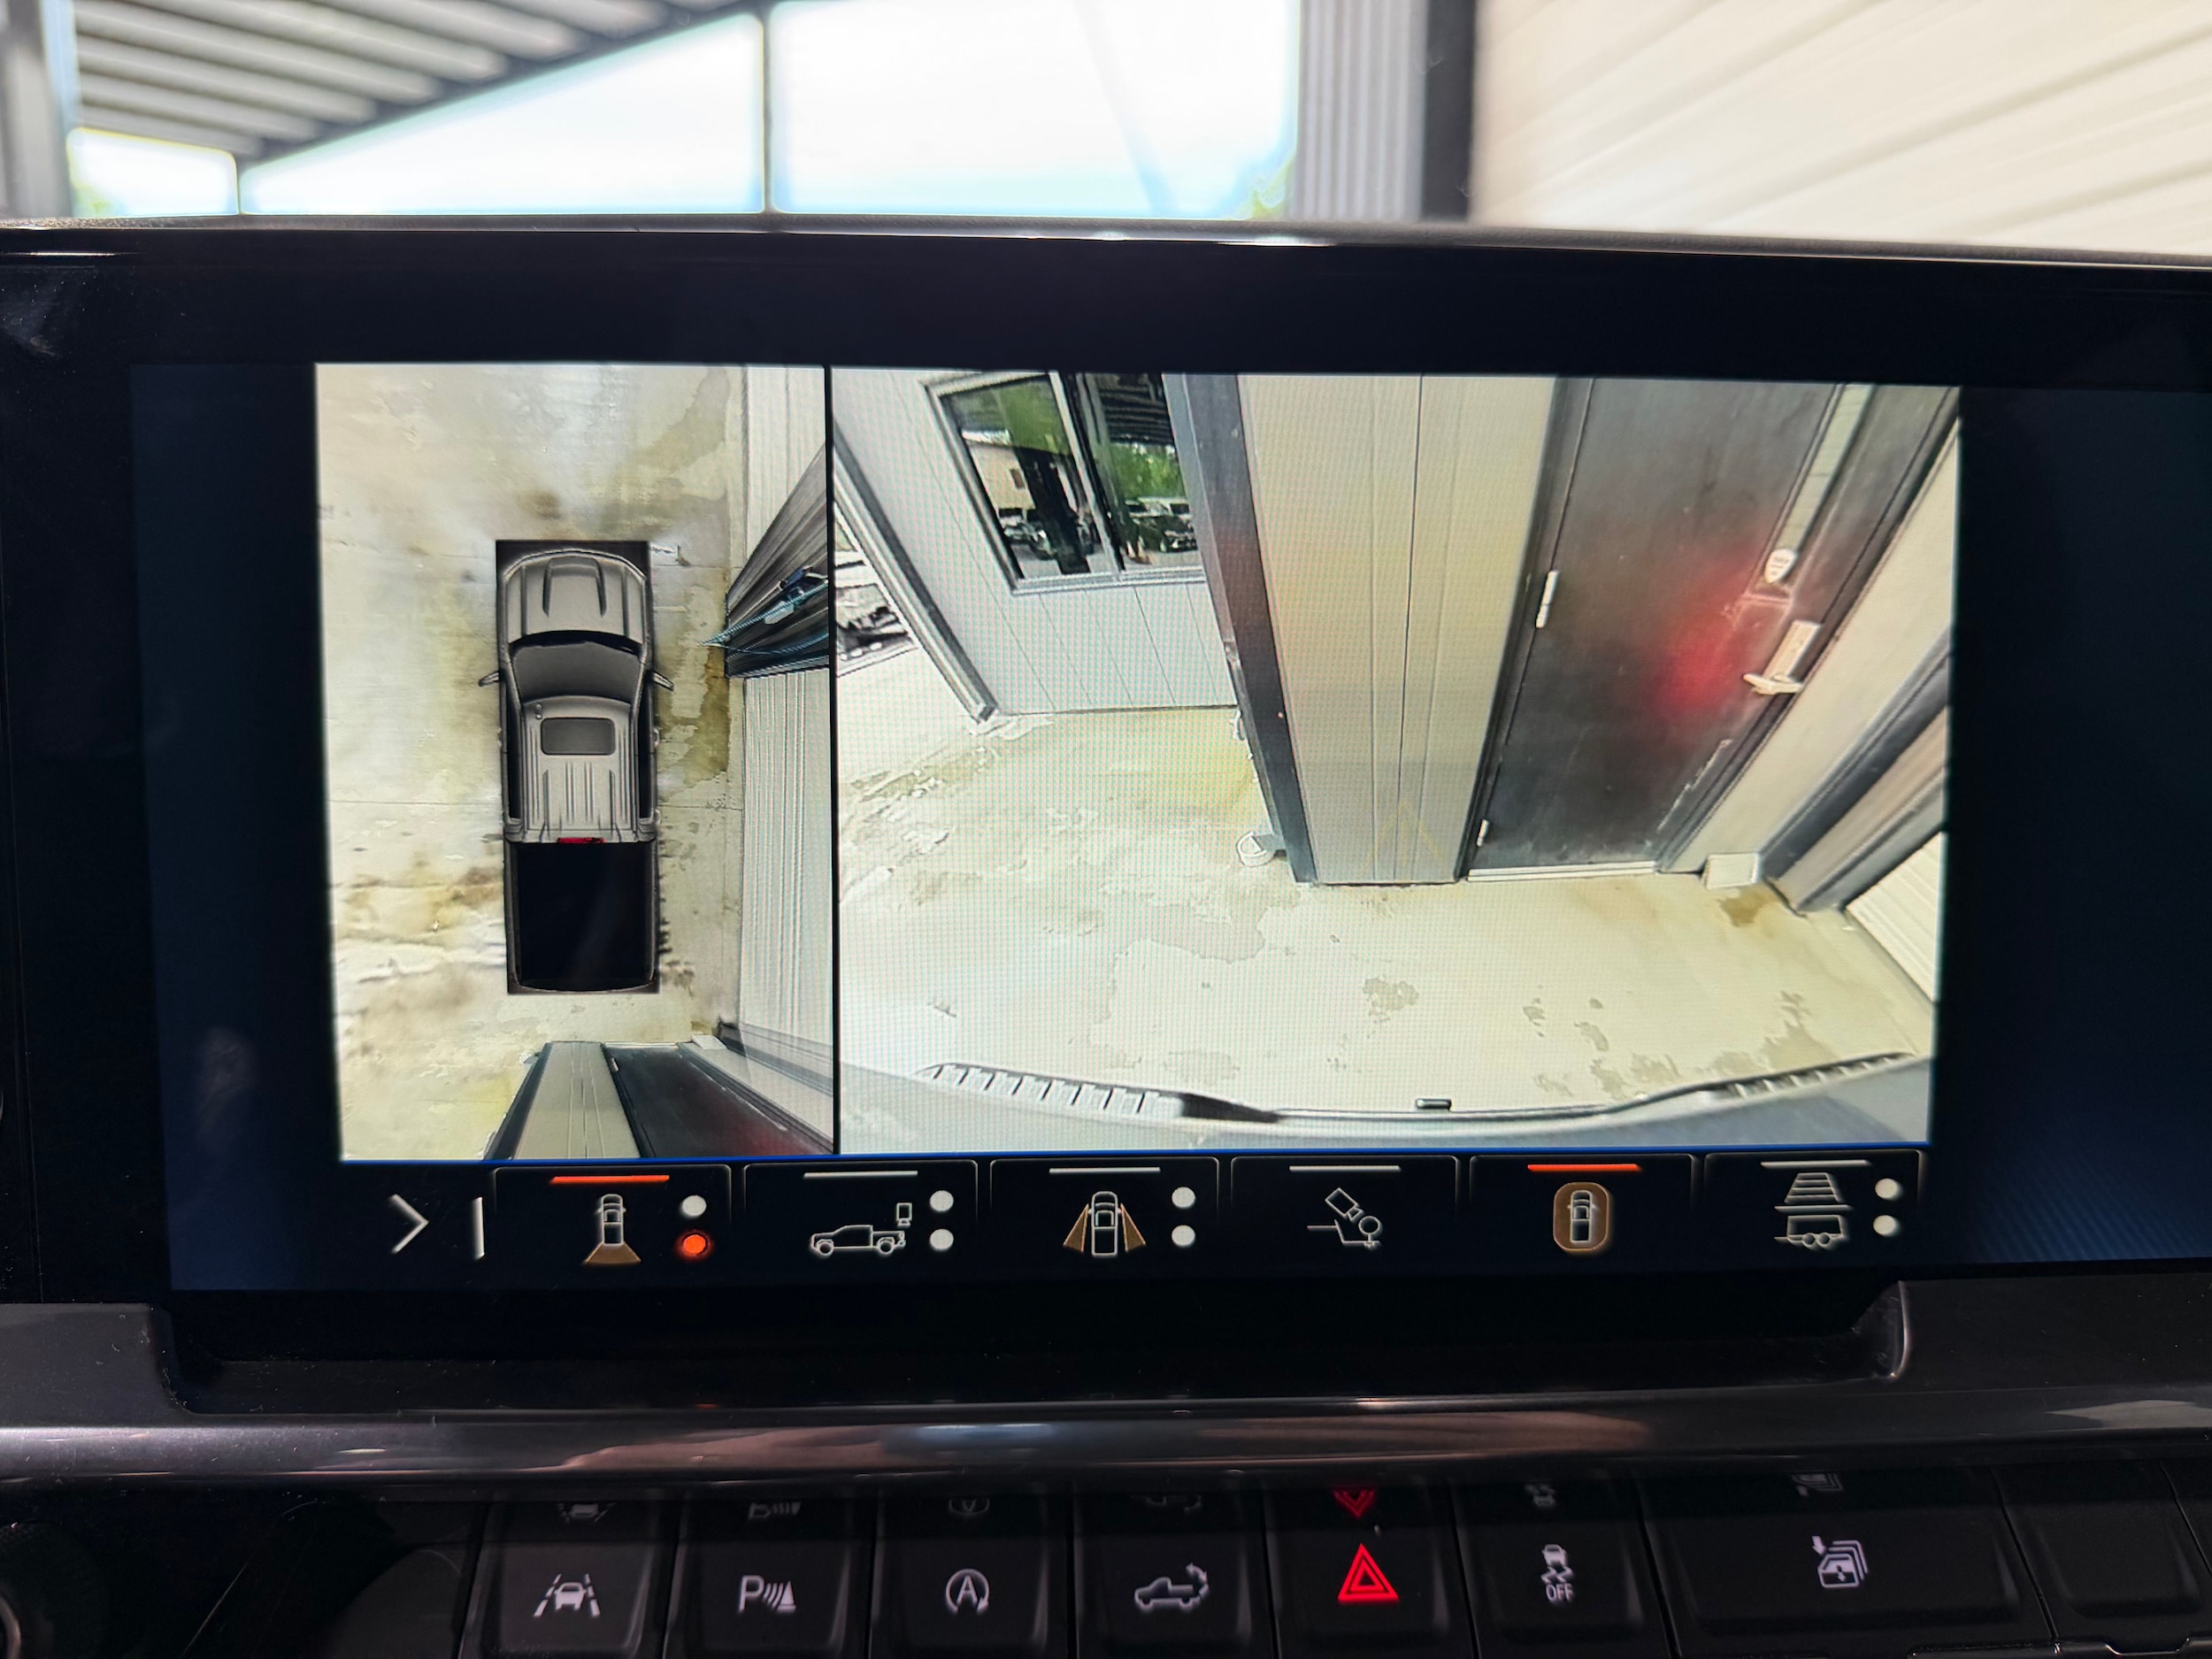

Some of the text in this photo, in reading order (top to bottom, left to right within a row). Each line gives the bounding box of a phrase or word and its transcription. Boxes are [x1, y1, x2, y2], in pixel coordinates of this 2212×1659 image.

[740, 1575, 764, 1611] P
[956, 1575, 978, 1603] A
[1546, 1583, 1573, 1601] OFF
